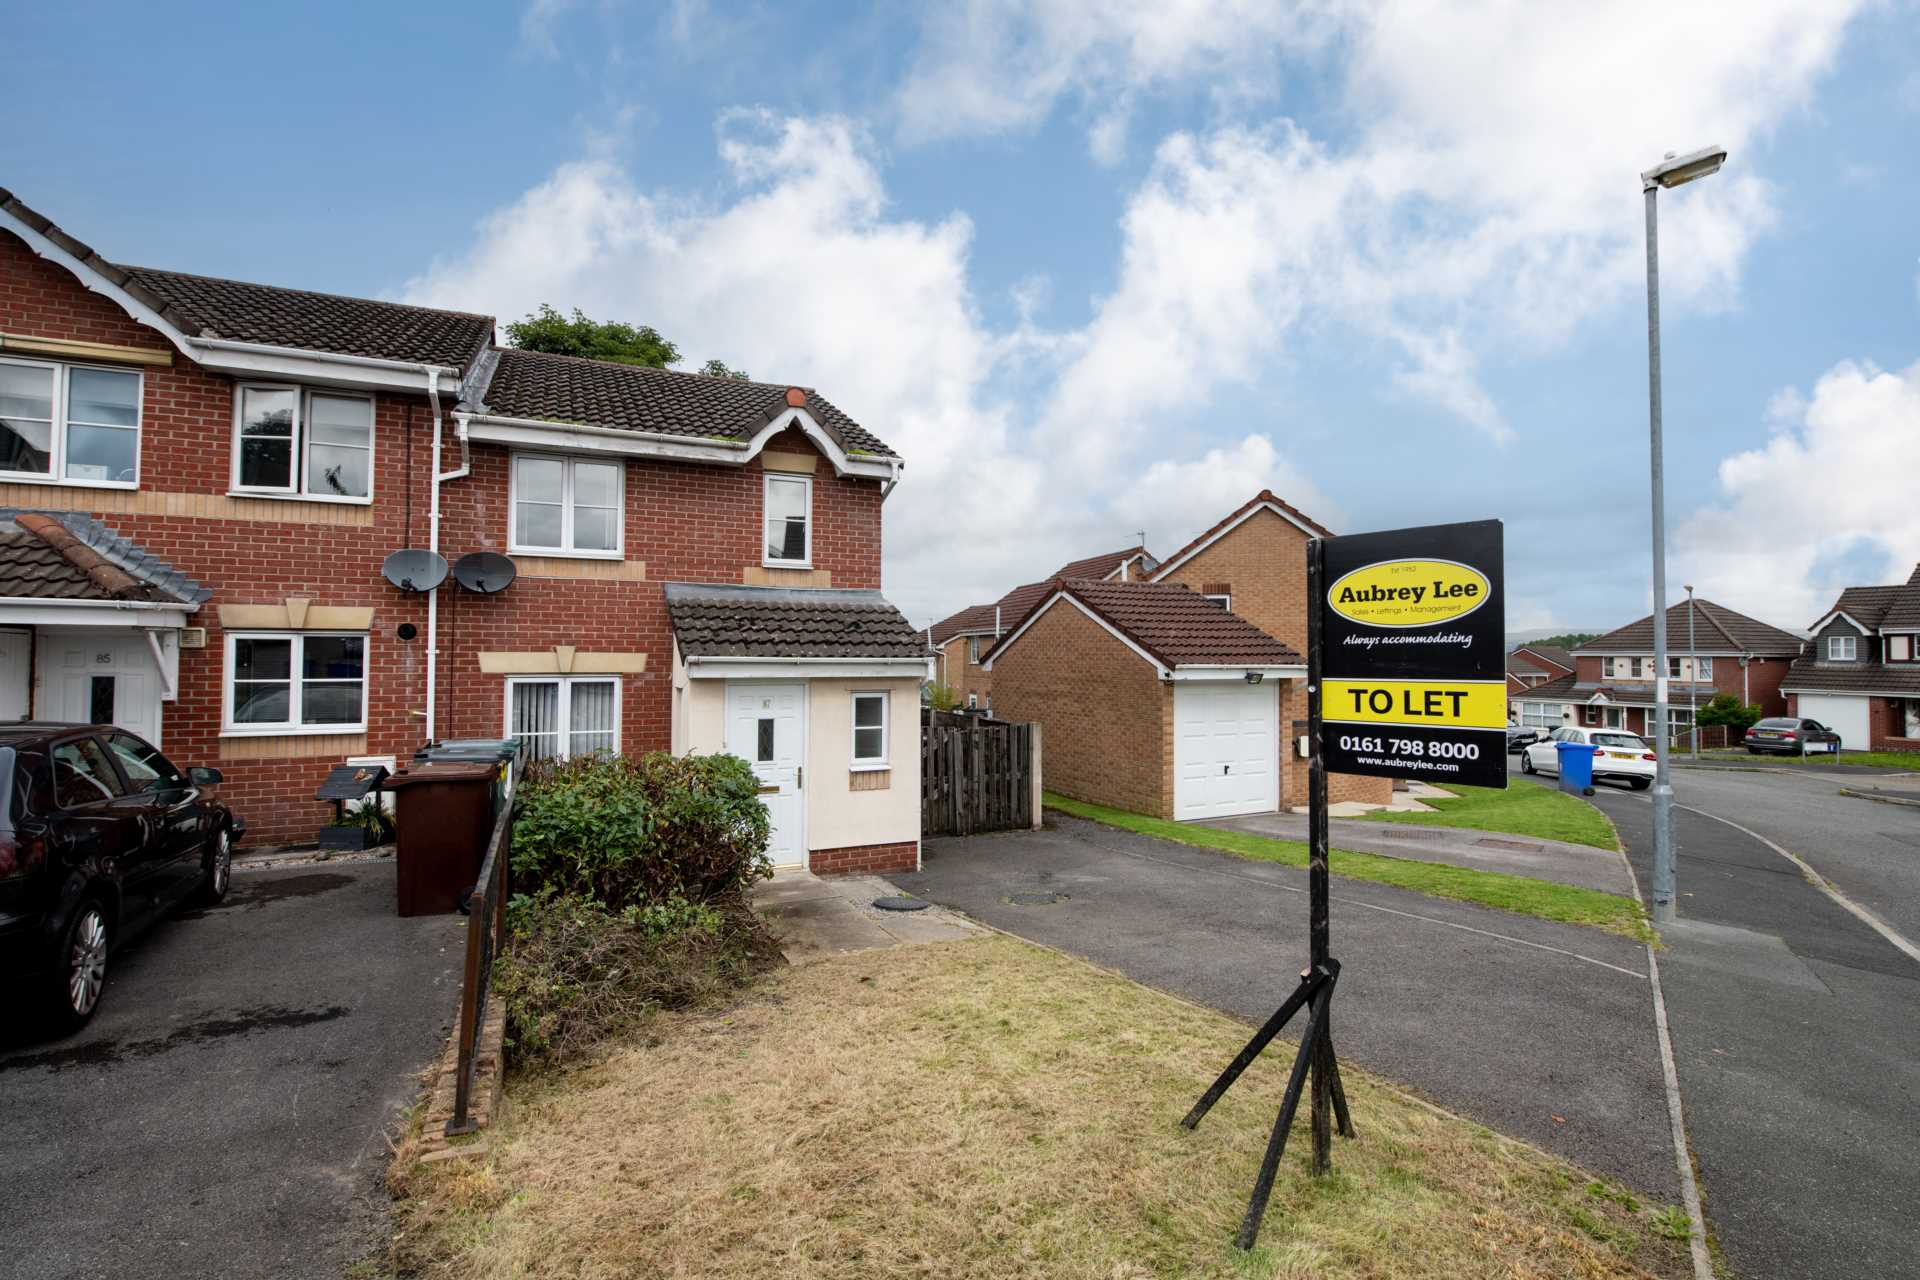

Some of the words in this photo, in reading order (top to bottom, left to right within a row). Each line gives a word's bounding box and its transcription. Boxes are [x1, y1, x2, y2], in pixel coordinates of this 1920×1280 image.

[1338, 584, 1427, 605] Aubrey
[1433, 580, 1479, 598] Lee
[1410, 603, 1462, 615] Management
[1343, 633, 1379, 650] Always
[1382, 631, 1473, 649] accommodating
[95, 653, 111, 664] 85
[1347, 688, 1393, 714] TO
[1403, 689, 1468, 717] LET
[1339, 736, 1384, 753] 0161
[1388, 738, 1424, 756] 798
[1428, 741, 1480, 760] 8000
[1357, 756, 1459, 772] www.aubreylee.com
